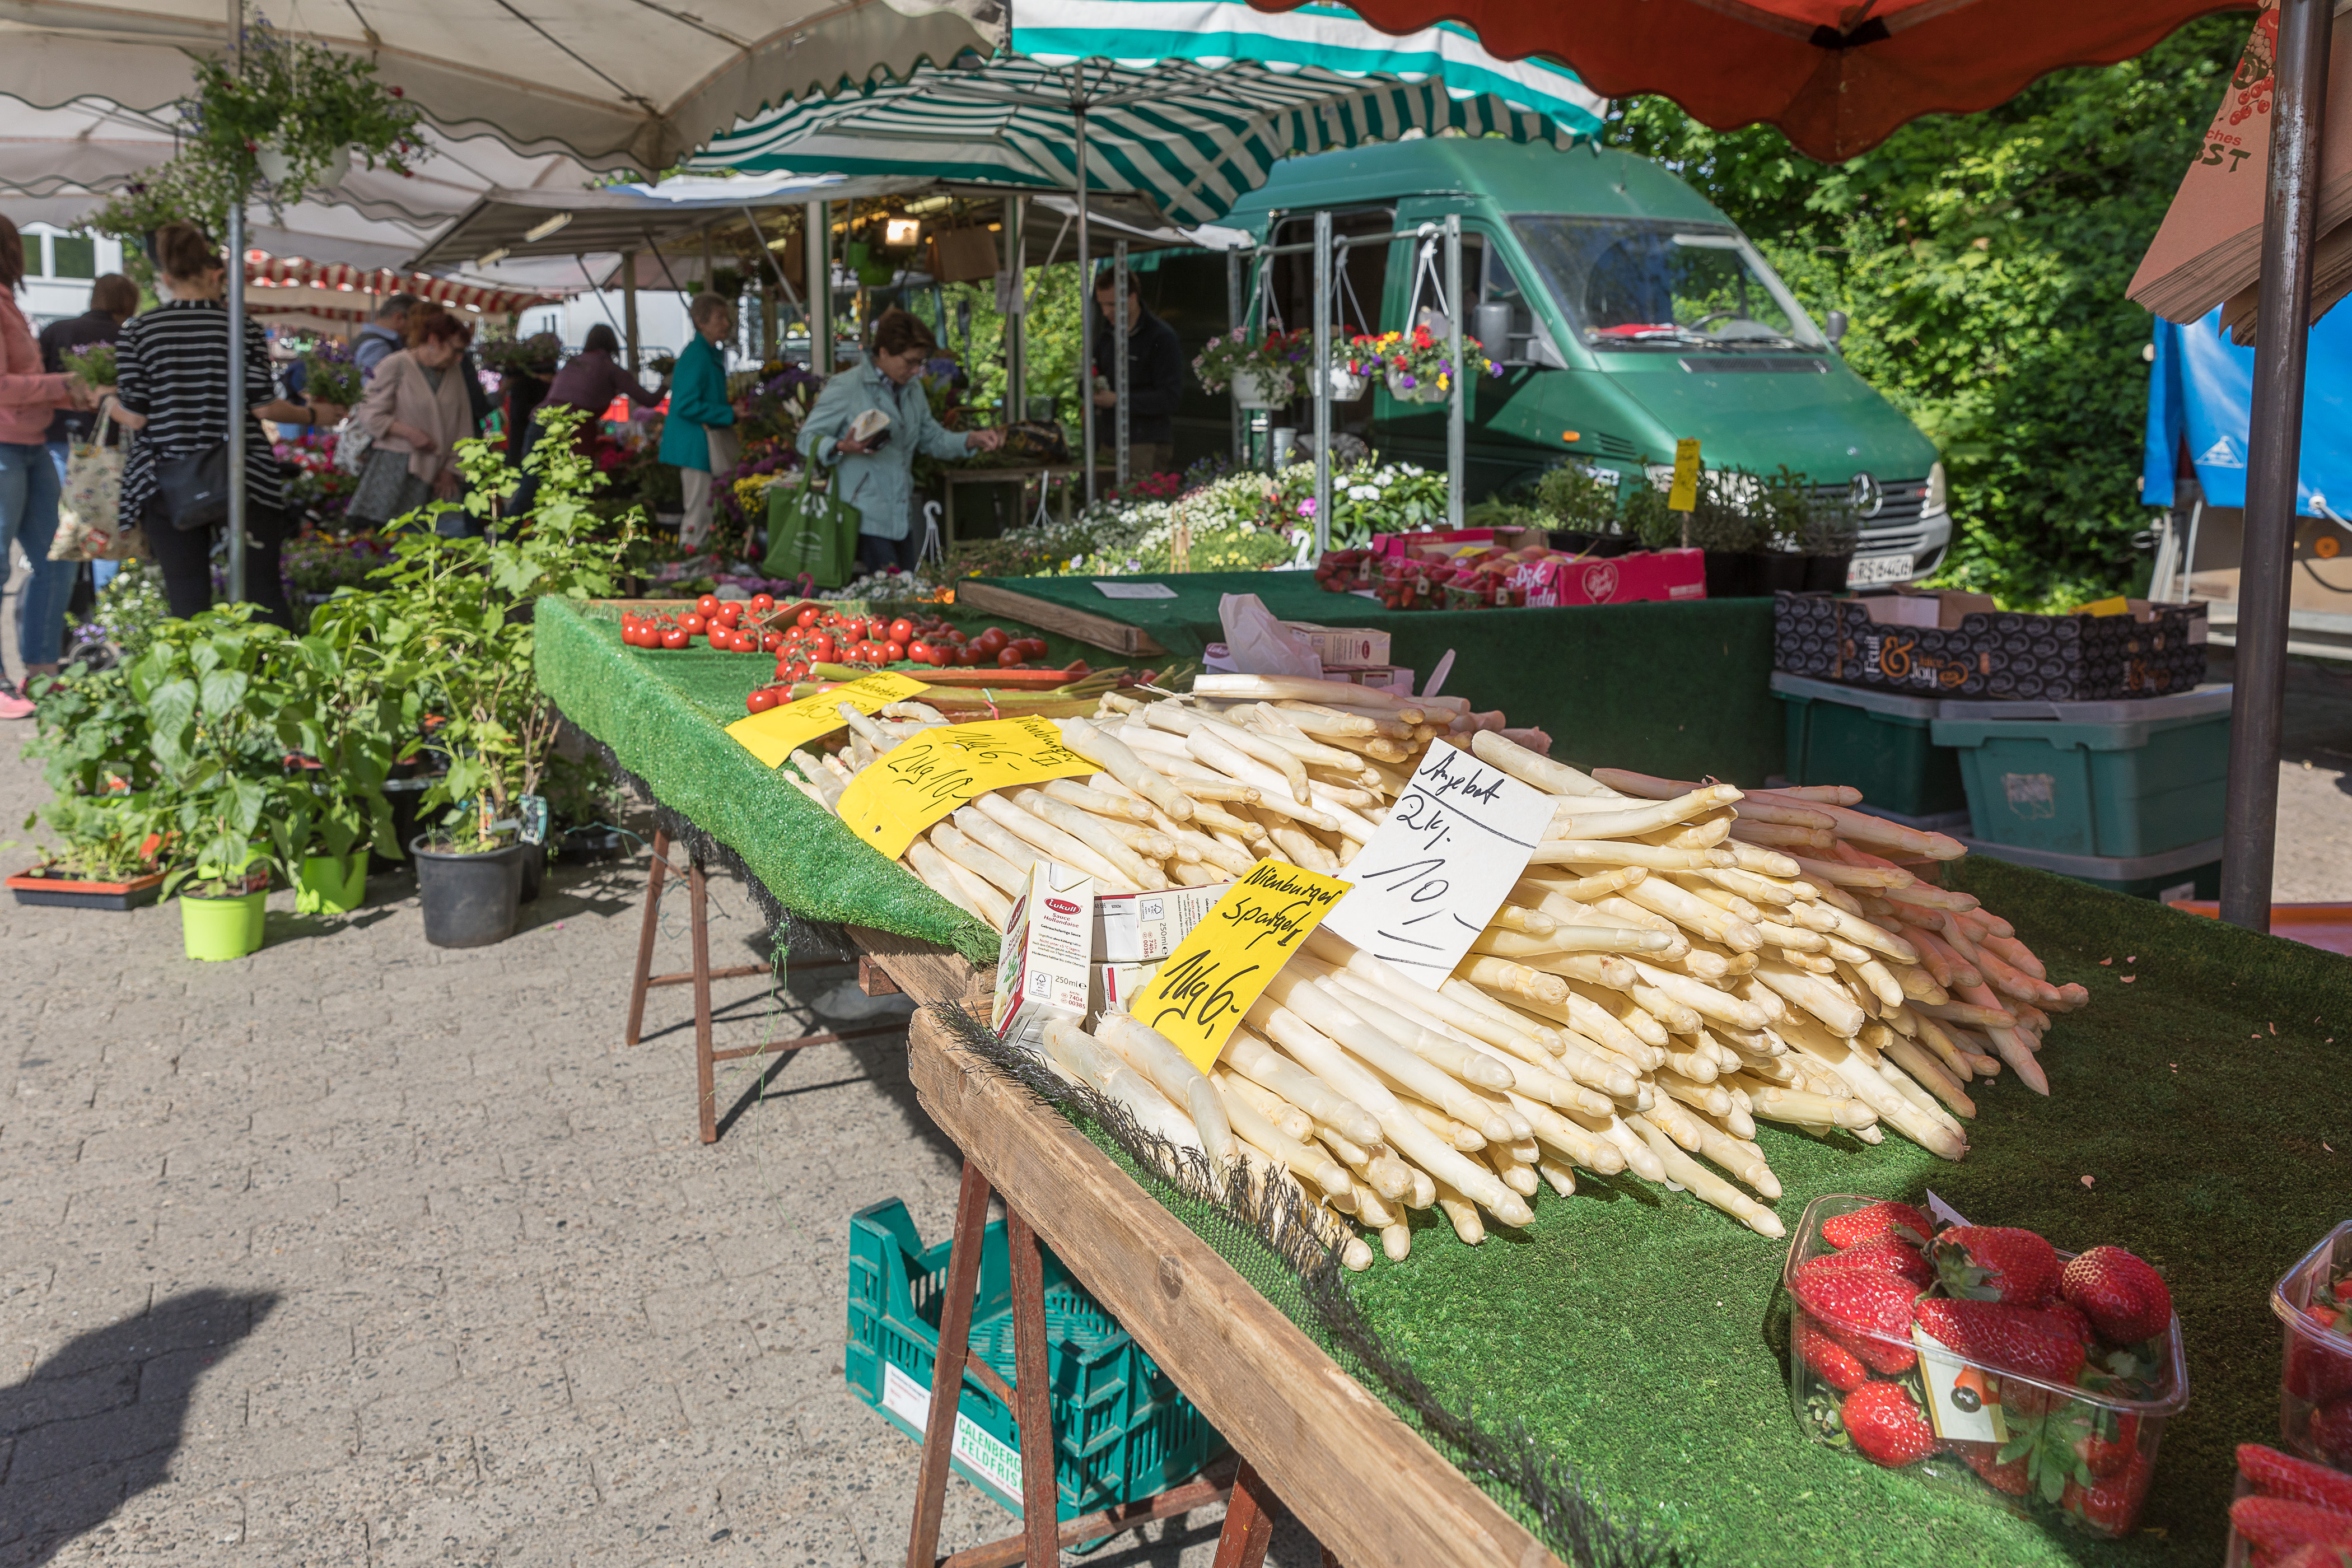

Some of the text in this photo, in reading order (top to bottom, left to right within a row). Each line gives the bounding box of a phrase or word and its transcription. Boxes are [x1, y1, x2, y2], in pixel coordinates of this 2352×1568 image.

[1420, 750, 1505, 805] Angebot
[1048, 898, 1077, 913] Lukull
[1043, 915, 1080, 928] Hollandaise
[1052, 913, 1071, 921] Sauce
[1040, 923, 1070, 935] Gebrauchsfertige
[1222, 897, 1312, 950] Spargel
[1055, 976, 1078, 988] 250ml
[1069, 994, 1082, 1002] 7404
[1068, 1000, 1086, 1009] 00385
